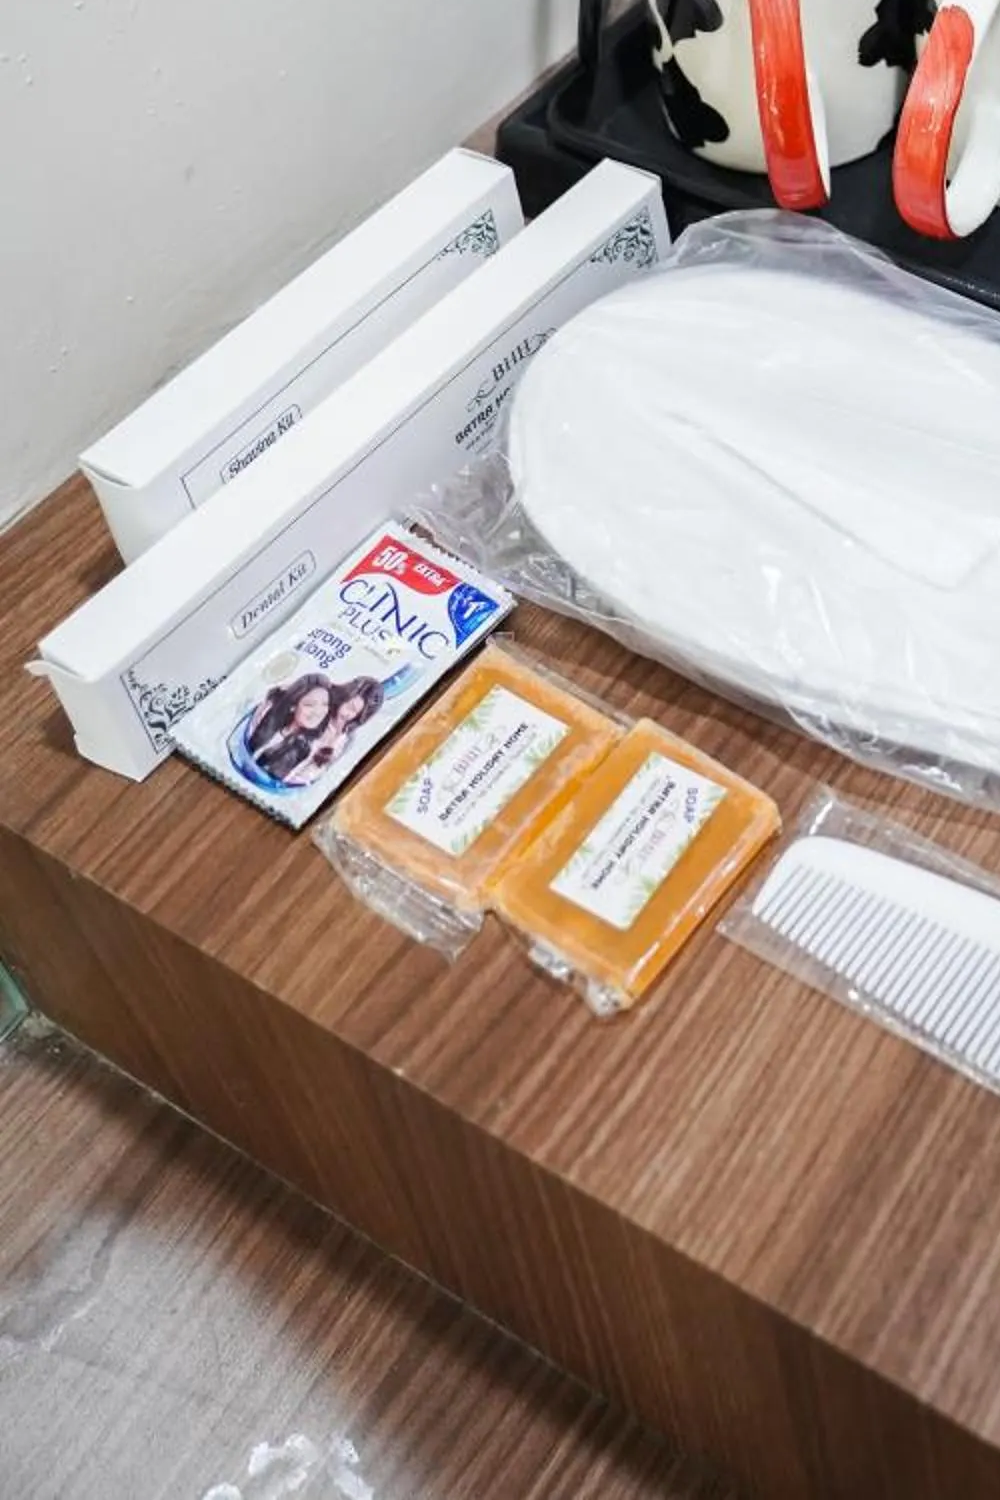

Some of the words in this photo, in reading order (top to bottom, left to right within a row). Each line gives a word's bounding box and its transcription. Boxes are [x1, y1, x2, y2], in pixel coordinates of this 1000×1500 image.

[242, 579, 285, 629] Dental
[288, 563, 306, 587] Kit
[339, 578, 450, 660] CLINIC
[338, 606, 394, 642] PLUS
[469, 749, 506, 789] HOLIDAY
[503, 721, 529, 749] HOME
[417, 777, 434, 815] SOAP
[684, 786, 699, 823] SOAP
